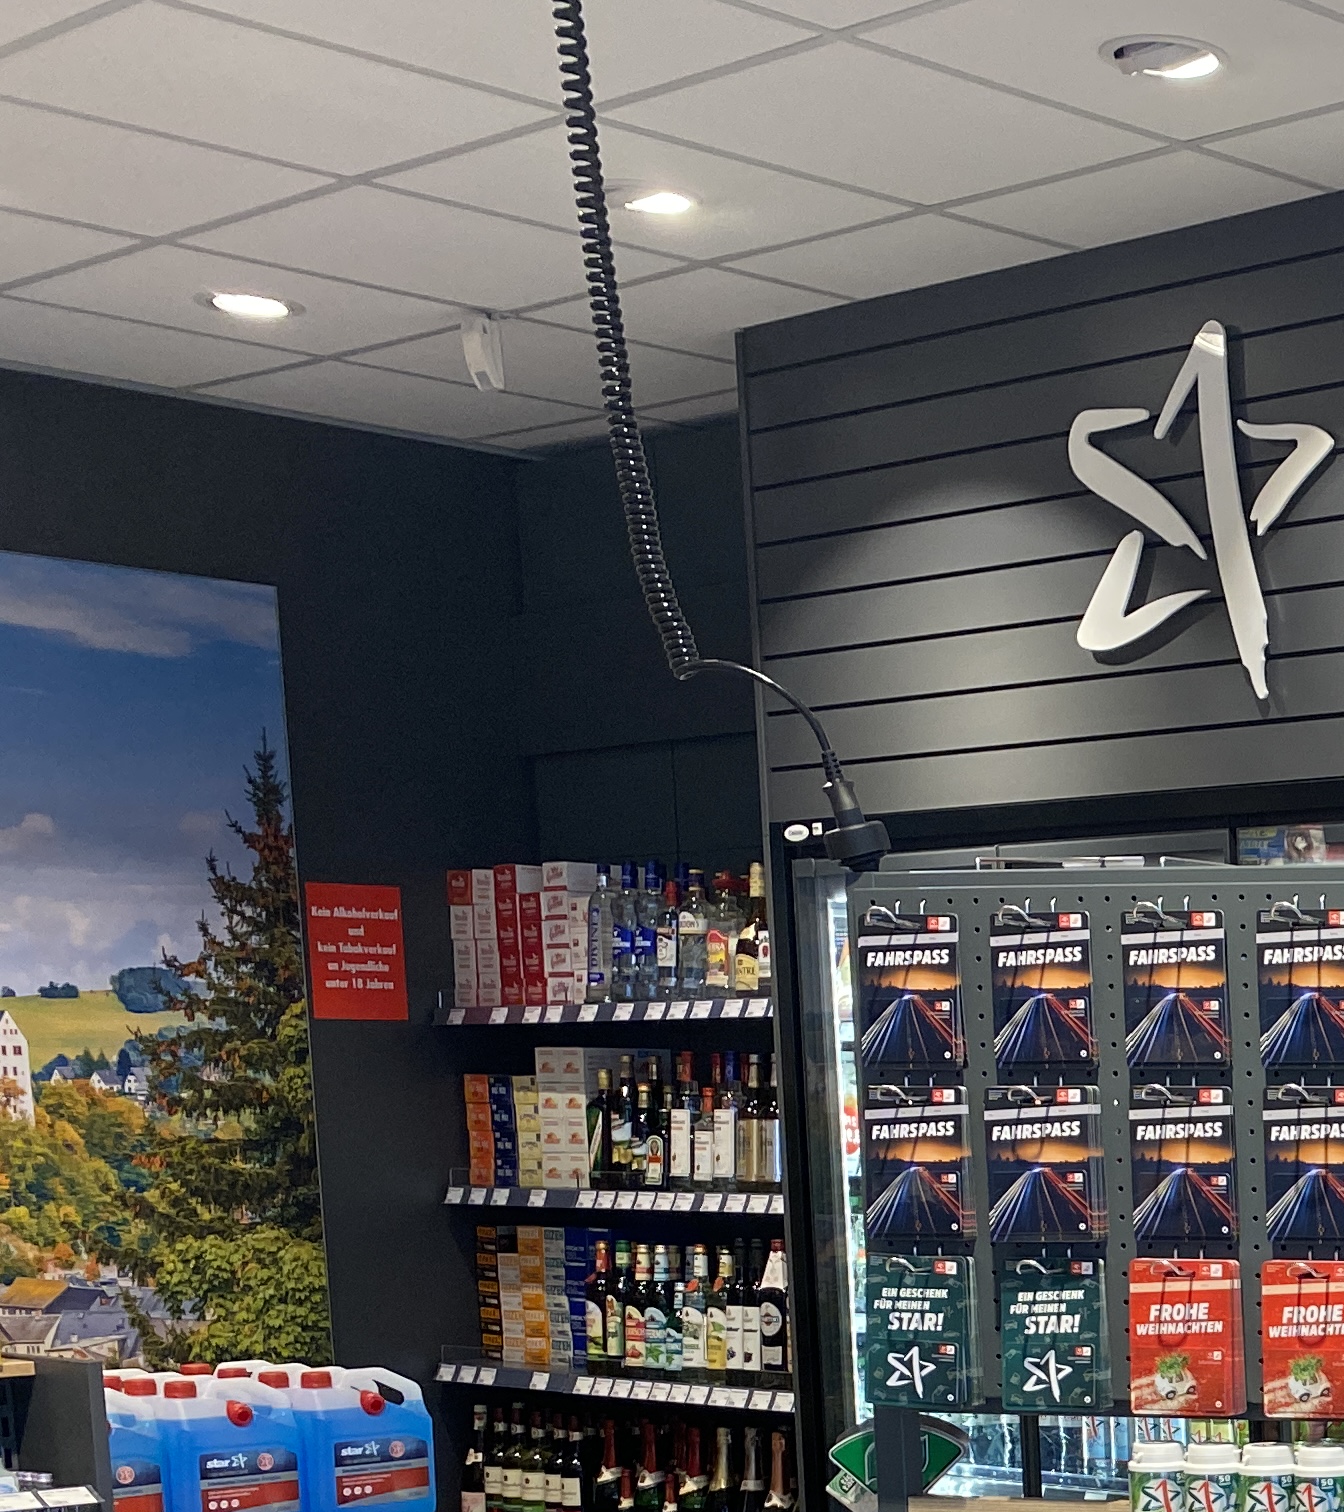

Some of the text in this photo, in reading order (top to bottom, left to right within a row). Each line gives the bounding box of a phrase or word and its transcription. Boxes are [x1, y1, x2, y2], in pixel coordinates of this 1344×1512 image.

[311, 906, 398, 920] Kein Alkoholverkauf
[317, 941, 397, 955] kein Tabakverkauf
[866, 948, 950, 967] FAHRSPASS
[997, 946, 1083, 968] FAHRSPASS
[1128, 945, 1217, 966] FAHRSPASS
[341, 960, 390, 974] Jugendliche
[325, 977, 394, 990] unter 18 Jahren
[871, 1121, 956, 1141] FAHRSPASS
[991, 1121, 1081, 1142] FAHRSPASS
[1136, 1121, 1224, 1141] FAHRSPASS
[882, 1288, 949, 1299] EIN GESCHENK
[1018, 1290, 1085, 1302] EIN GESCHENK
[874, 1299, 930, 1311] FÜR MEINEN
[1010, 1303, 1066, 1315] FÜR MEINEN
[1149, 1303, 1210, 1321] FROHE
[1282, 1304, 1344, 1323] FROHE
[887, 1312, 944, 1331] STAR!
[1024, 1314, 1081, 1334] STAR!
[1136, 1321, 1223, 1335] WEIHNACHTEN
[341, 1444, 364, 1457] star
[206, 1456, 230, 1469] star
